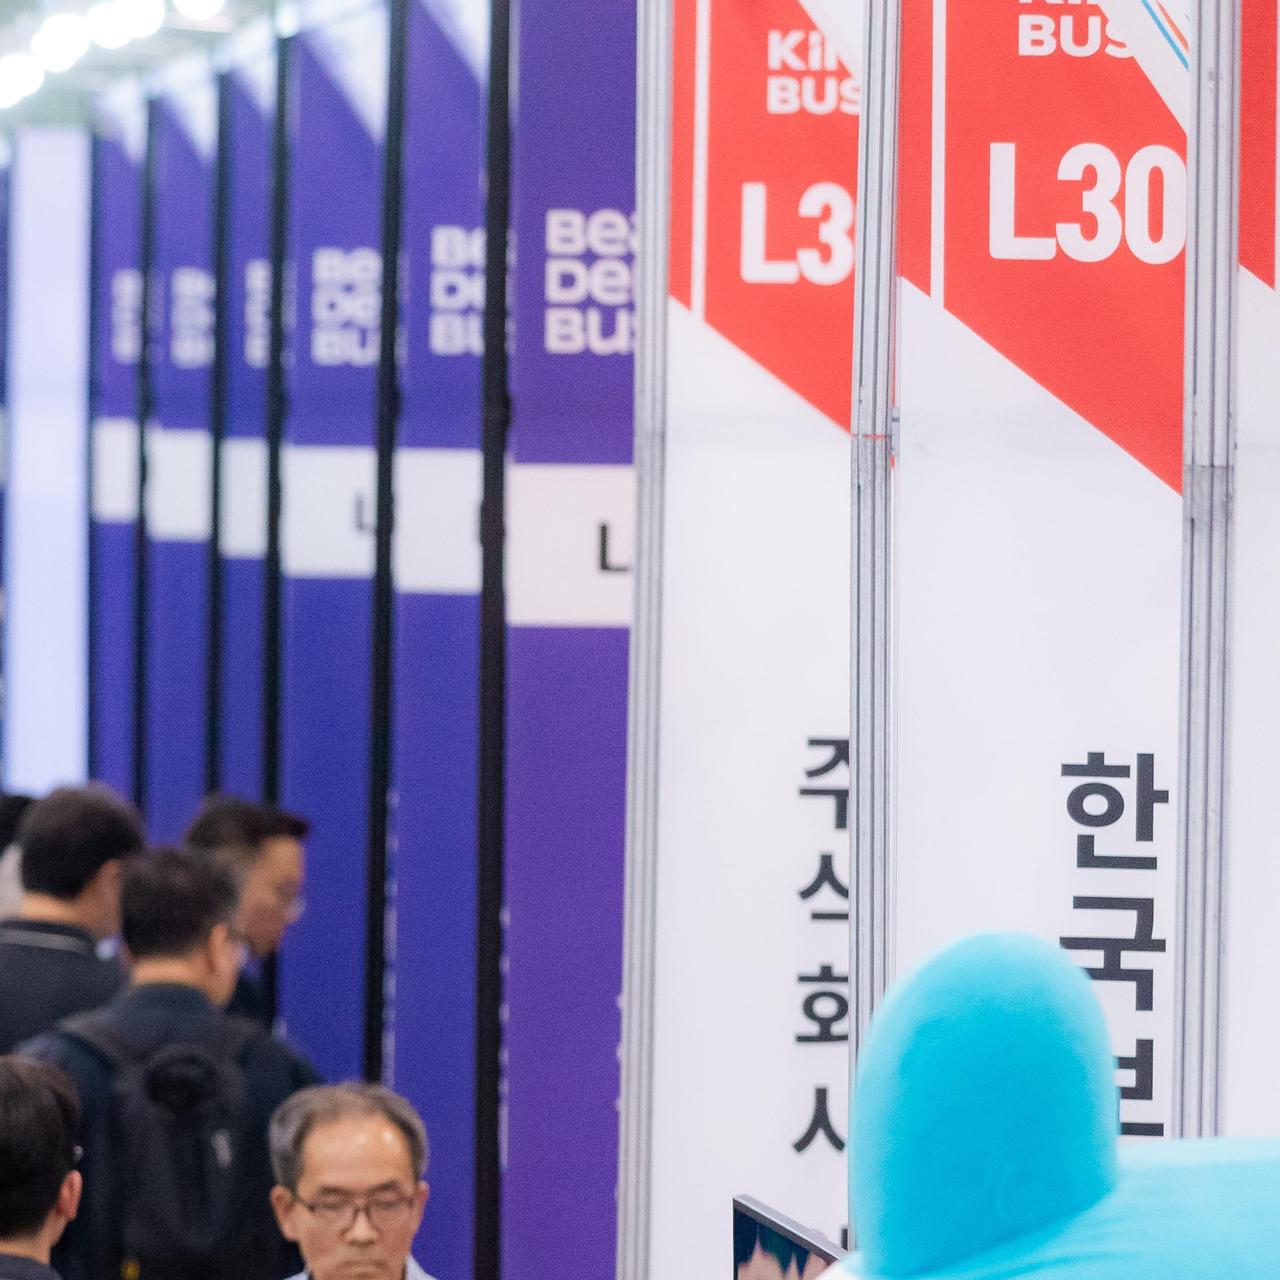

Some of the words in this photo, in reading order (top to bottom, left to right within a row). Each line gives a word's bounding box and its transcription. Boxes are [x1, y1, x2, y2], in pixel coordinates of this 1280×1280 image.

[545, 208, 637, 256] Be
[740, 182, 856, 286] L3
[989, 141, 1187, 265] L30
[545, 306, 635, 356] Bu
